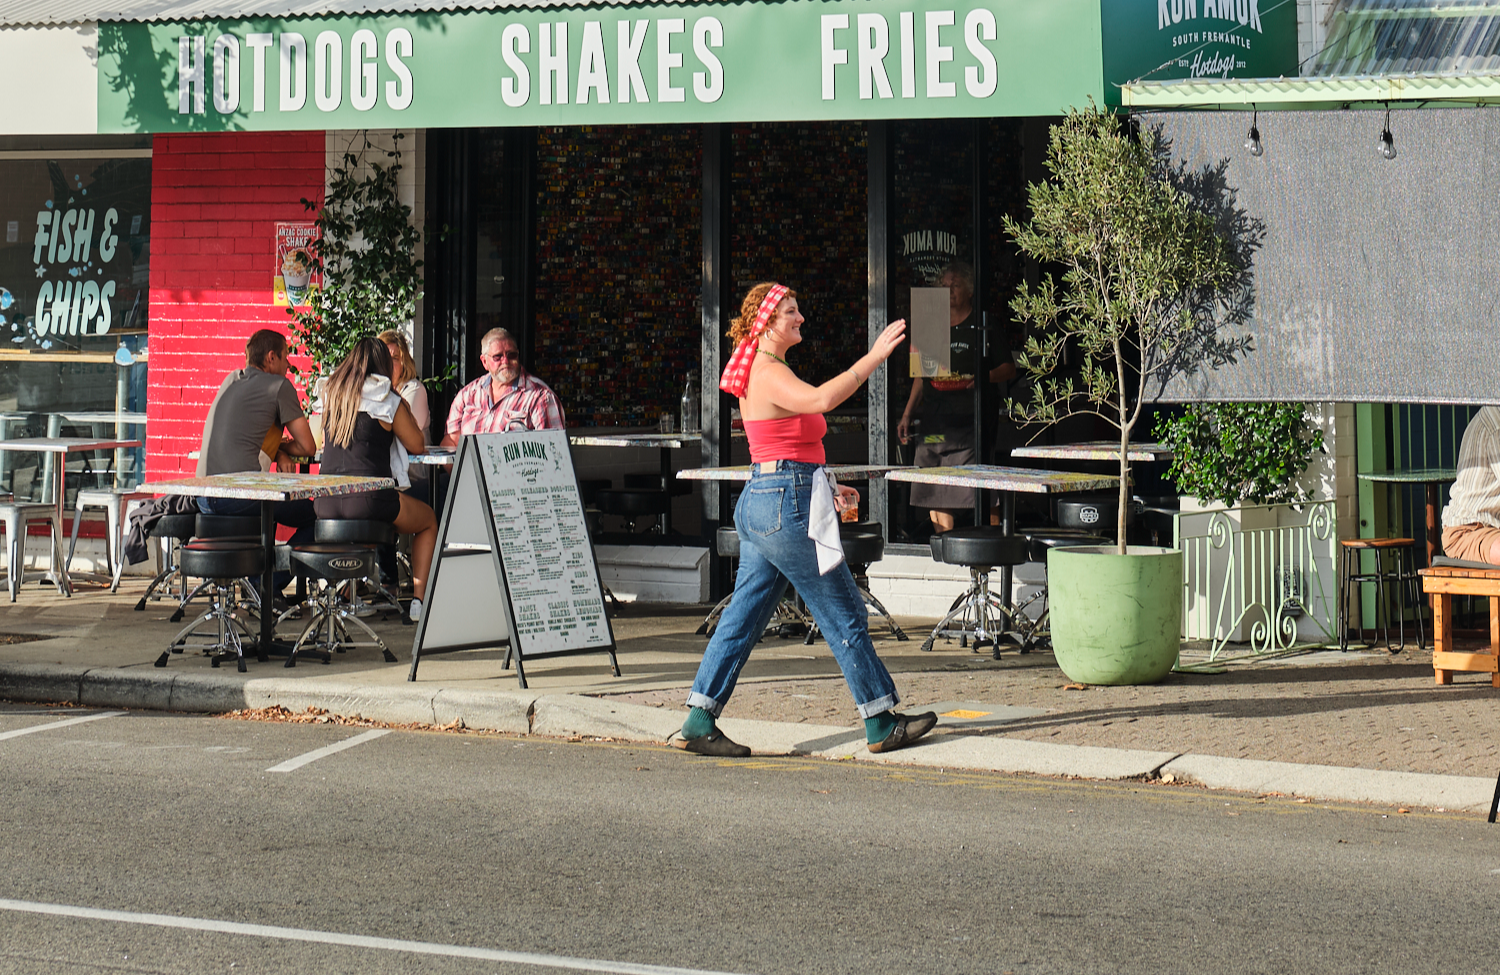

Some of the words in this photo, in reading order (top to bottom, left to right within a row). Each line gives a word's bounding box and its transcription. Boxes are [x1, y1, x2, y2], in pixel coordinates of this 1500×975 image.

[1172, 31, 1198, 47] SOUTH
[1202, 31, 1251, 50] FREMANTLE
[178, 27, 414, 115] HOTDOGS
[501, 16, 725, 109] SHAKES
[820, 8, 999, 101] FRIES
[1190, 50, 1235, 79] Hotdogs
[33, 208, 96, 265] FISH
[100, 207, 119, 263] &
[278, 228, 296, 237] ANZAC
[296, 228, 316, 236] COOKIE
[35, 280, 117, 337] CHIPS
[502, 441, 521, 464] RUN
[521, 440, 548, 461] AMUK
